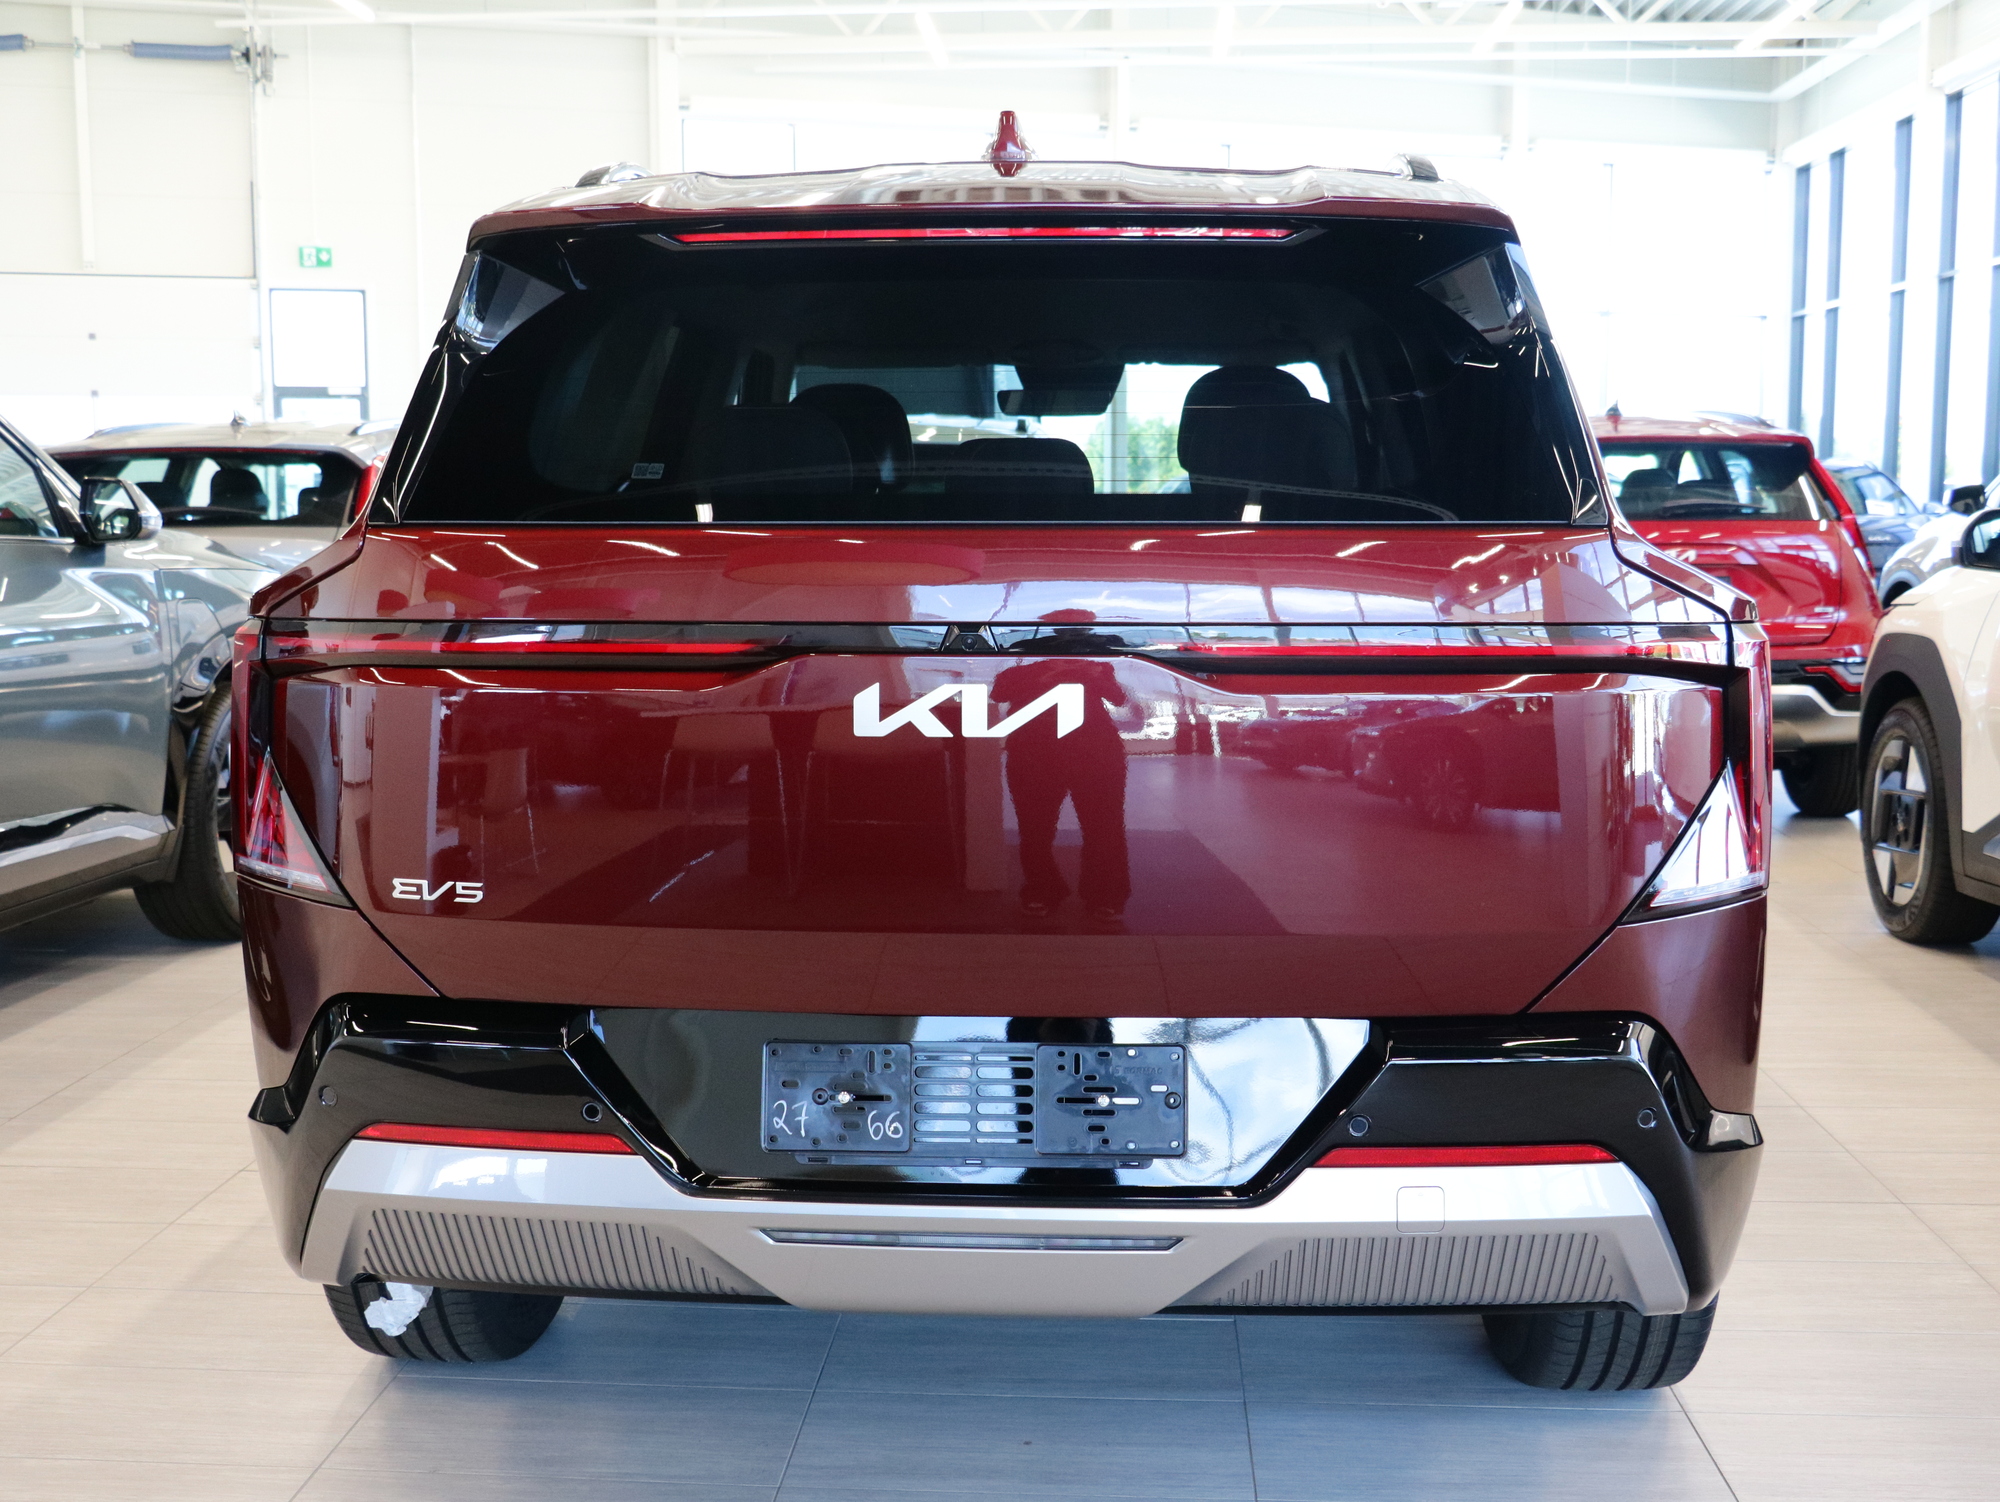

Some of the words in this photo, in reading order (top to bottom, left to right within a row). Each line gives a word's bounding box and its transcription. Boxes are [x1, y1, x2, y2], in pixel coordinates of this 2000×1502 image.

[853, 682, 1085, 739] KIA
[392, 878, 484, 904] EV5
[773, 1099, 809, 1138] 27
[867, 1109, 903, 1141] 66
